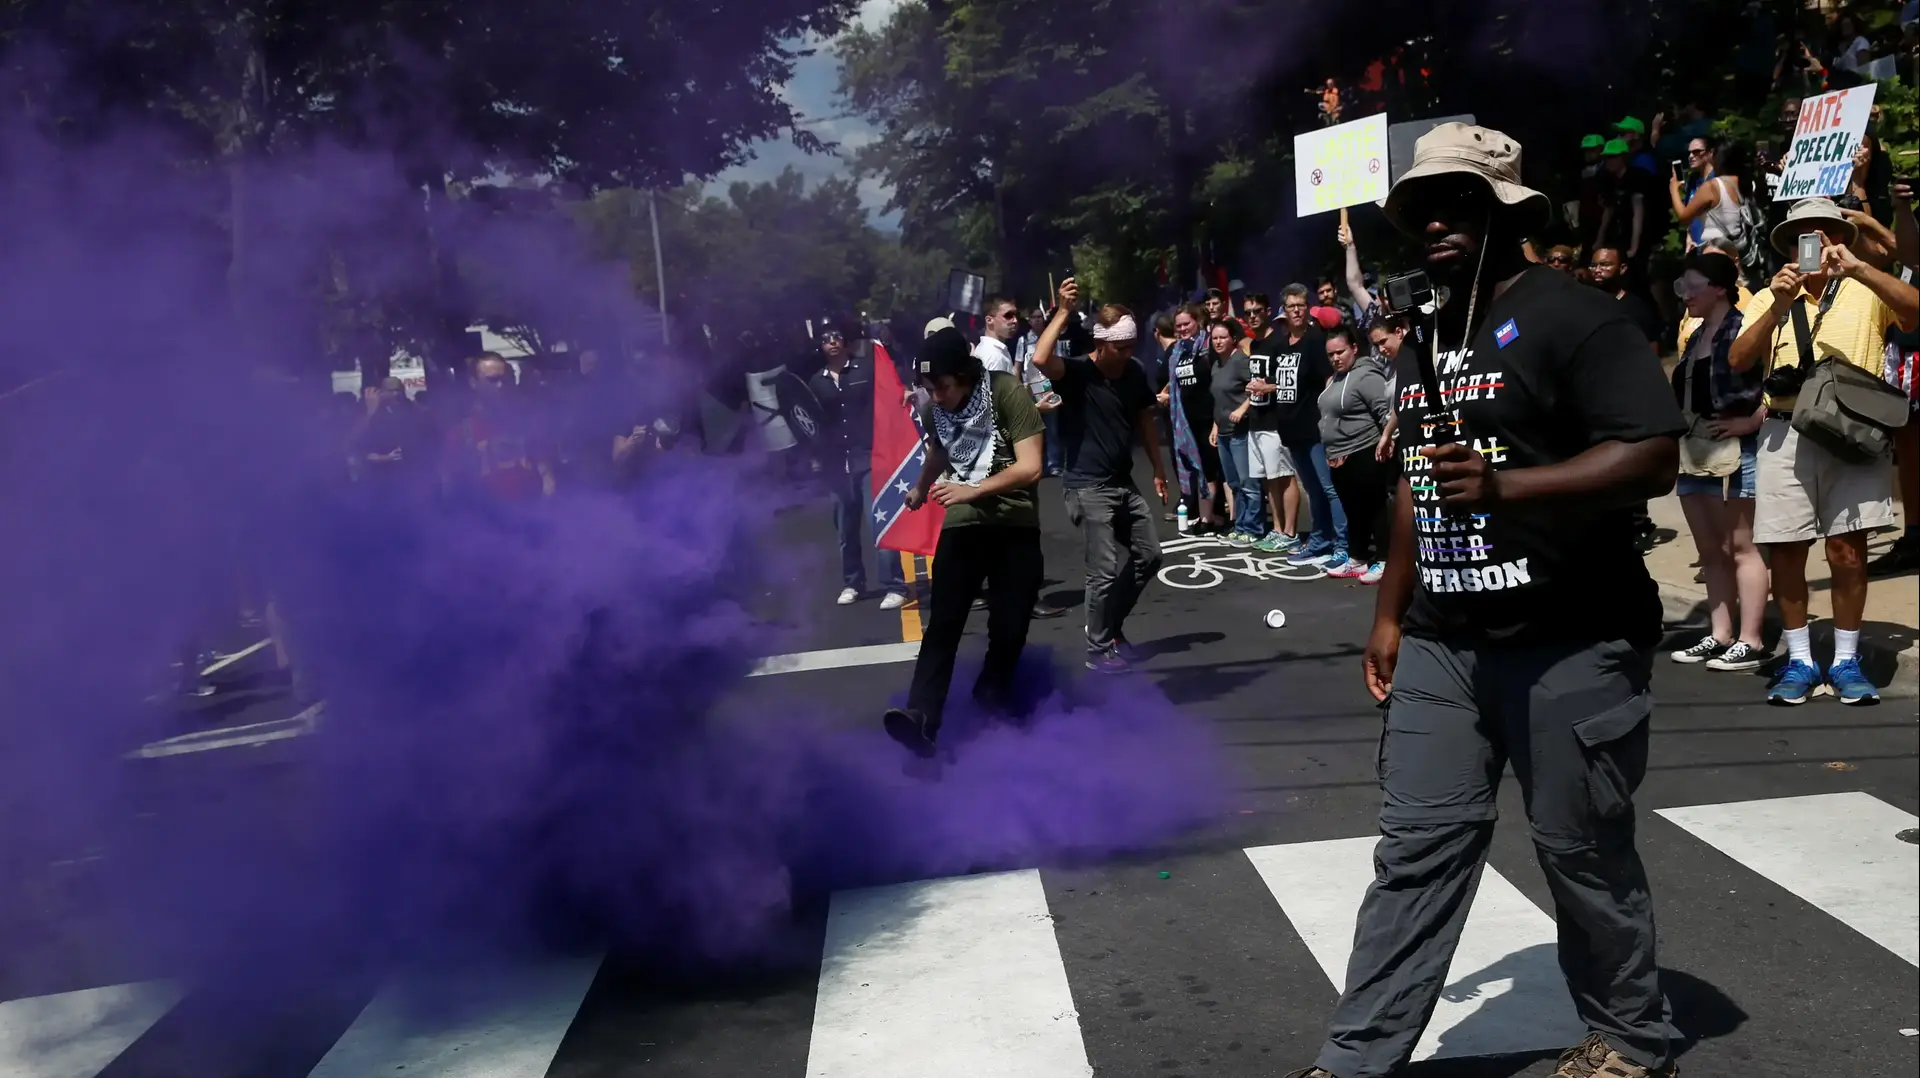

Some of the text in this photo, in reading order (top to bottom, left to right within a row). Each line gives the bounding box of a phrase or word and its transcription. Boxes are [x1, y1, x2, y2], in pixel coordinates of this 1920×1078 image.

[1796, 89, 1848, 136] HATE
[1788, 132, 1851, 168] SPEECH
[1780, 171, 1816, 197] Never
[1421, 557, 1531, 592] PERSON
